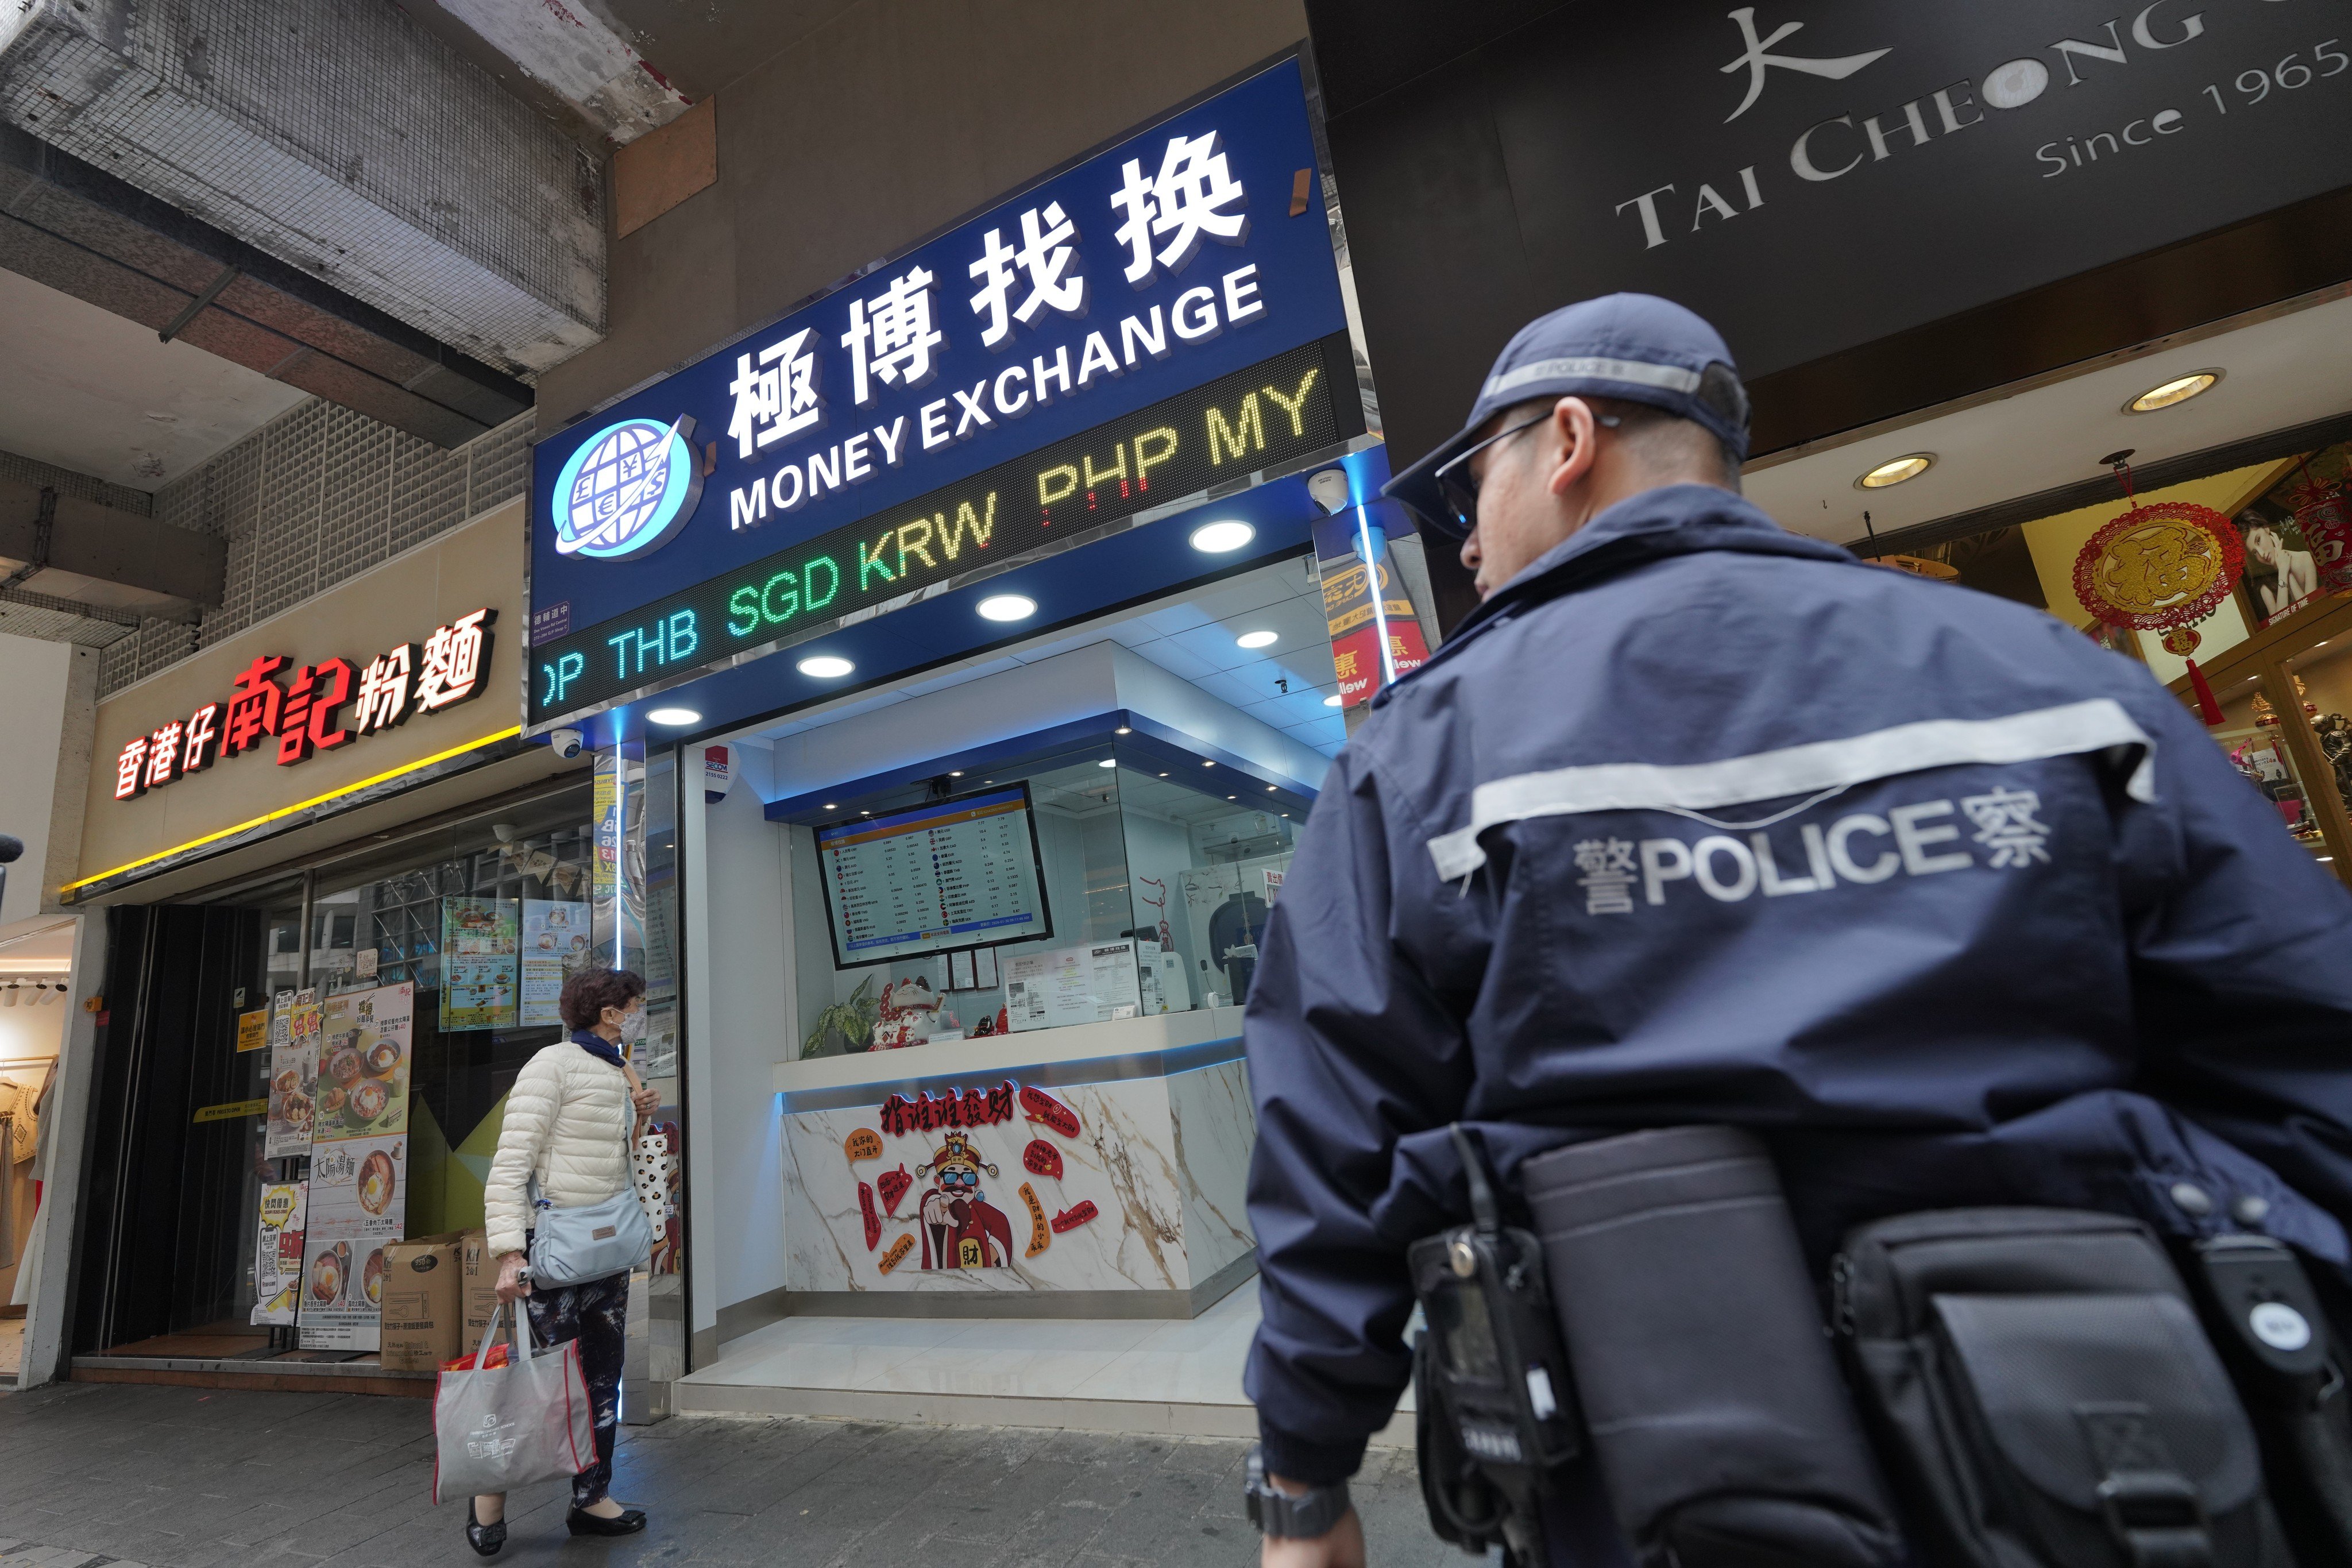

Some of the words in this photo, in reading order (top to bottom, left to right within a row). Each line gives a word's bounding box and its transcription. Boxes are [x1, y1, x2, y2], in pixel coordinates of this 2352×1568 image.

[1718, 6, 1894, 125] 大
[2035, 109, 2184, 179] Since
[2201, 38, 2351, 115] 1965
[1615, 165, 1766, 250] TAI
[1789, 0, 2207, 182] CHEONG
[727, 129, 1246, 459] 極博找換
[731, 415, 906, 531] MONEY
[920, 264, 1264, 450] EXCHANGE
[608, 609, 698, 680] THB
[729, 555, 840, 638] SGD
[860, 491, 997, 592] KRW
[1038, 426, 1178, 526] PHP
[1207, 368, 1319, 466] MY
[2104, 526, 2211, 608] 福
[534, 605, 567, 626] 德輔道中
[555, 617, 567, 625] Central
[2268, 608, 2290, 626] SIGNATURE
[2291, 604, 2297, 613] OF
[2297, 597, 2309, 609] TIME
[114, 608, 489, 801] 香港仔南記粉麵
[706, 762, 727, 771] SECOM
[1572, 836, 1637, 916] 警
[1639, 797, 1974, 906] POLICE
[1959, 786, 2052, 868] 察
[852, 1135, 873, 1147] 我家的
[854, 1145, 878, 1157] 大门直开
[1033, 1142, 1059, 1161] 财神老爷
[1027, 1158, 1043, 1173] 家里来
[1030, 1150, 1047, 1165] 到我的
[265, 1198, 289, 1209] 快閃優惠
[466, 1248, 480, 1262] KH
[879, 1258, 890, 1270] Money
[890, 1249, 898, 1258] come
[962, 1245, 979, 1265] 財
[466, 1266, 478, 1276] 2合1
